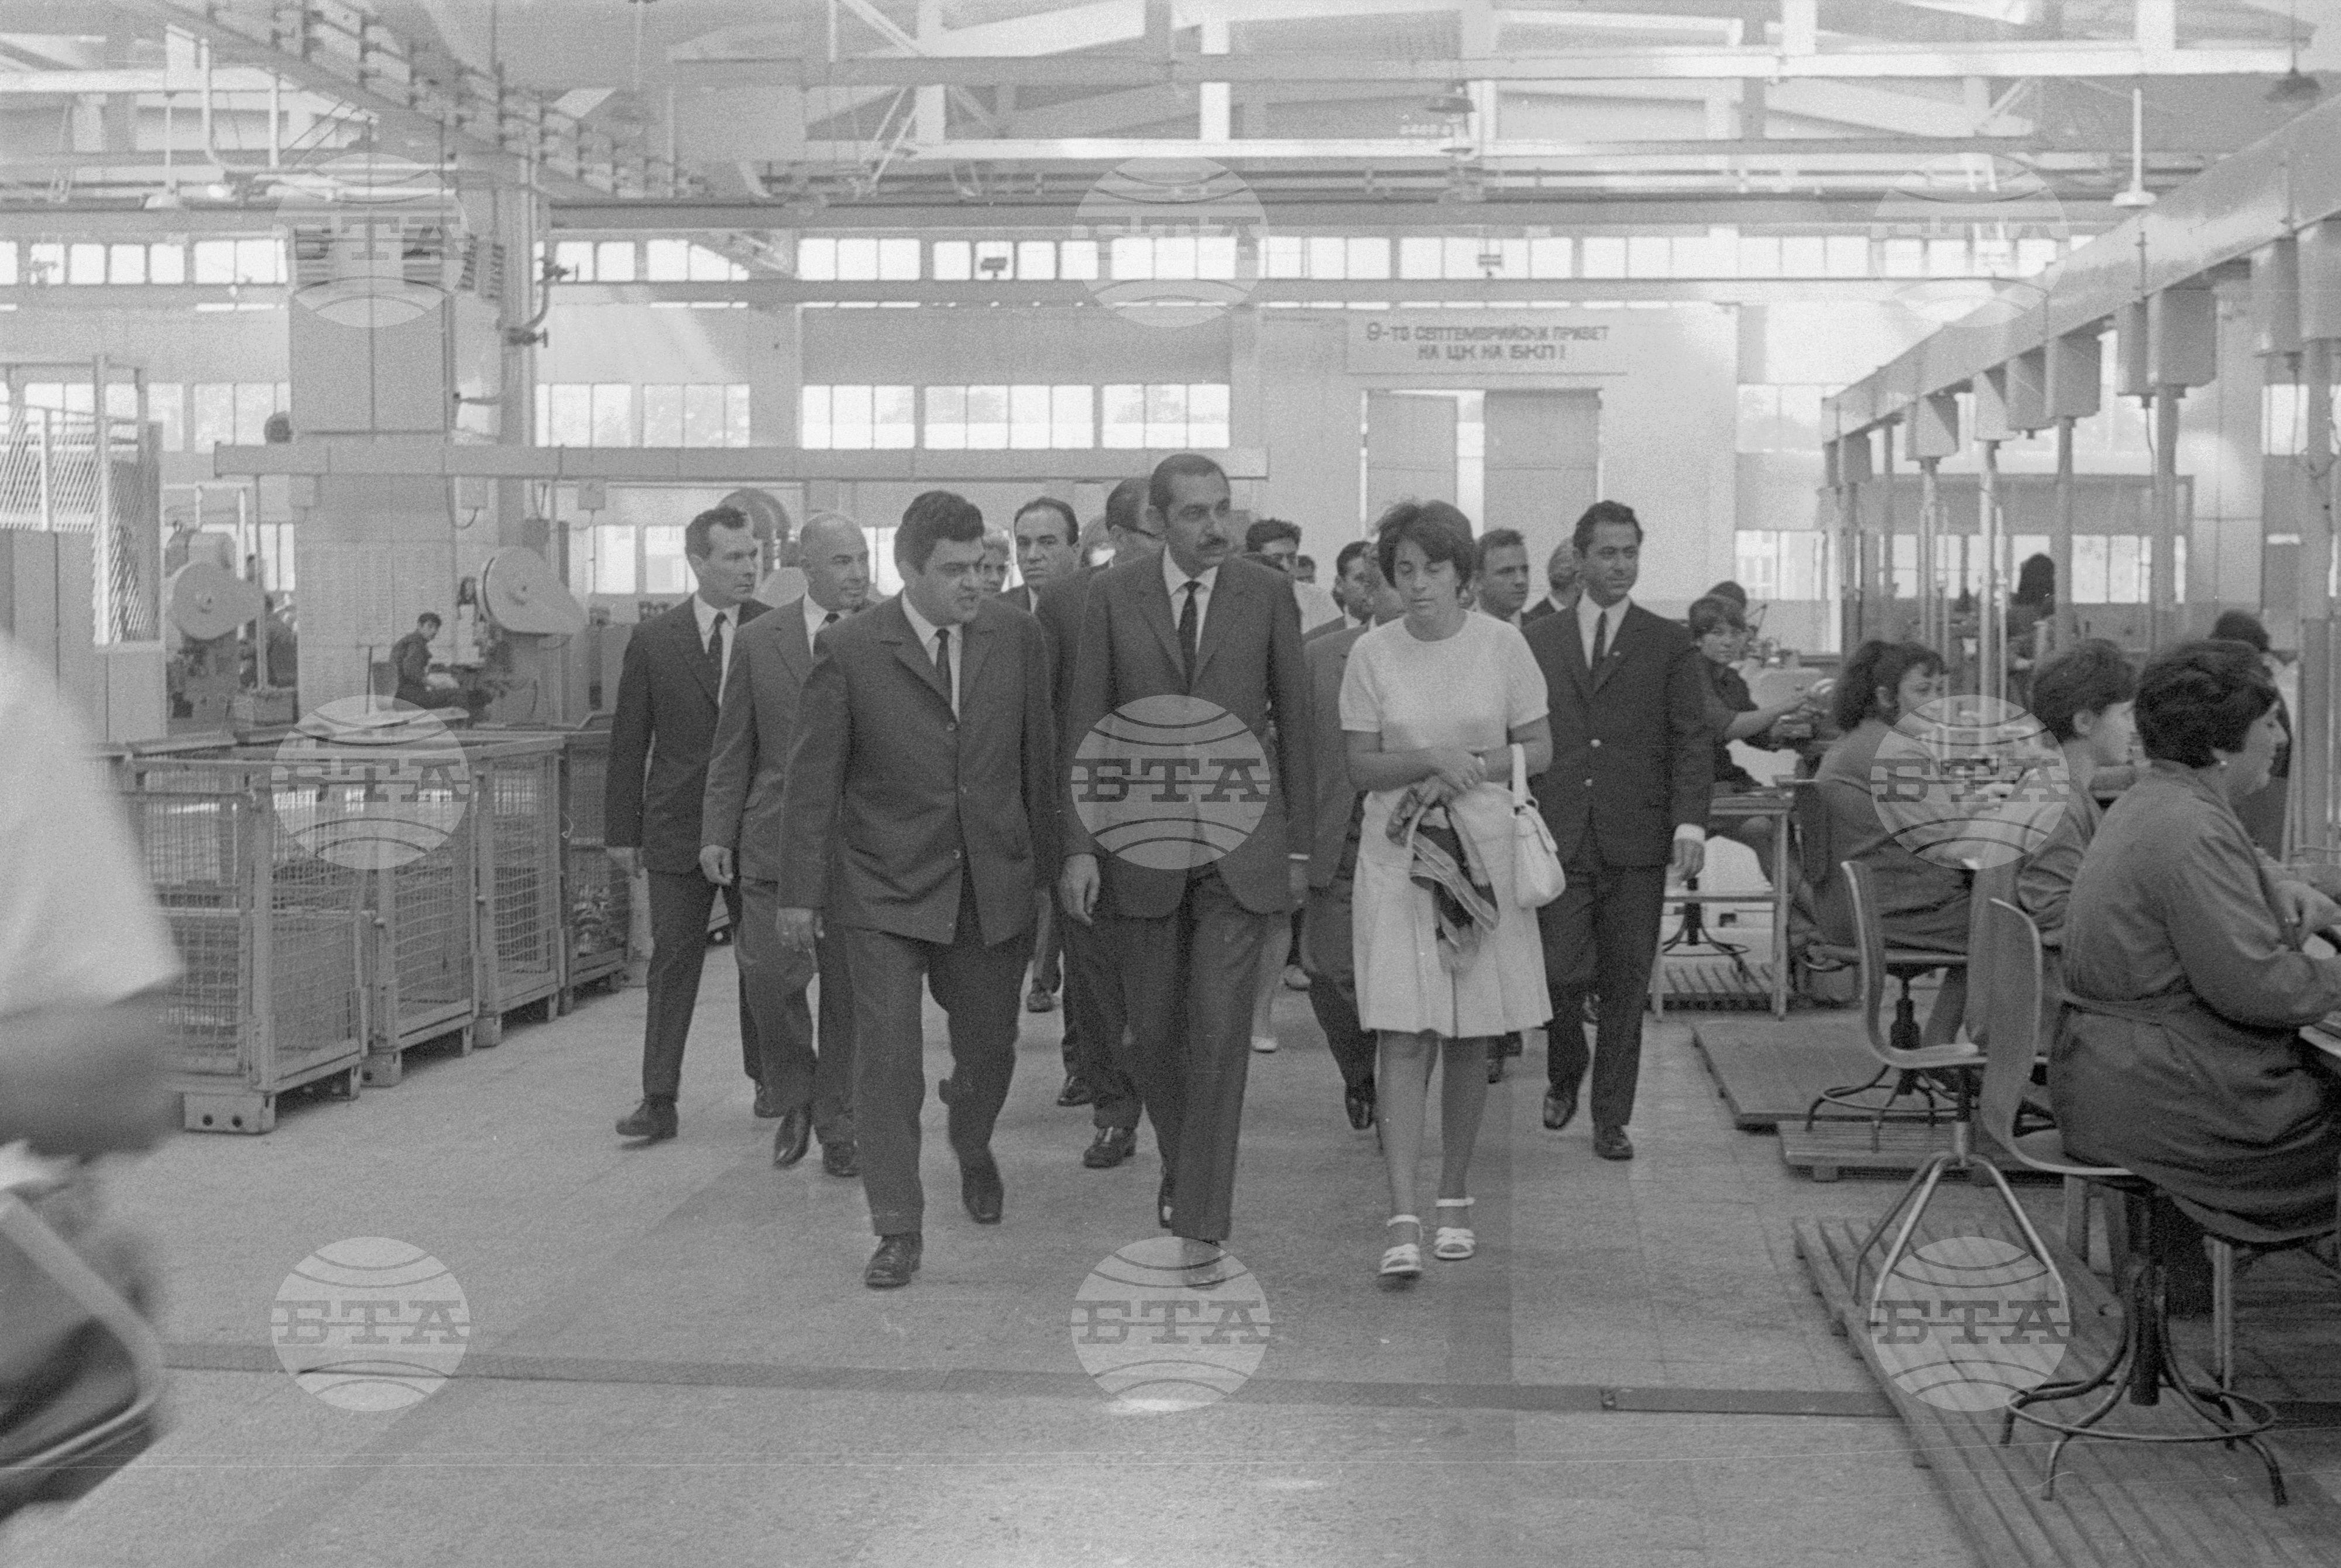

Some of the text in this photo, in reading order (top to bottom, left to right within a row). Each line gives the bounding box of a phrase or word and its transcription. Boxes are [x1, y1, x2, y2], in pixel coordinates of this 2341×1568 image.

[1418, 344, 1439, 360] НА
[1446, 344, 1475, 361] ЦК
[1482, 344, 1502, 360] НА
